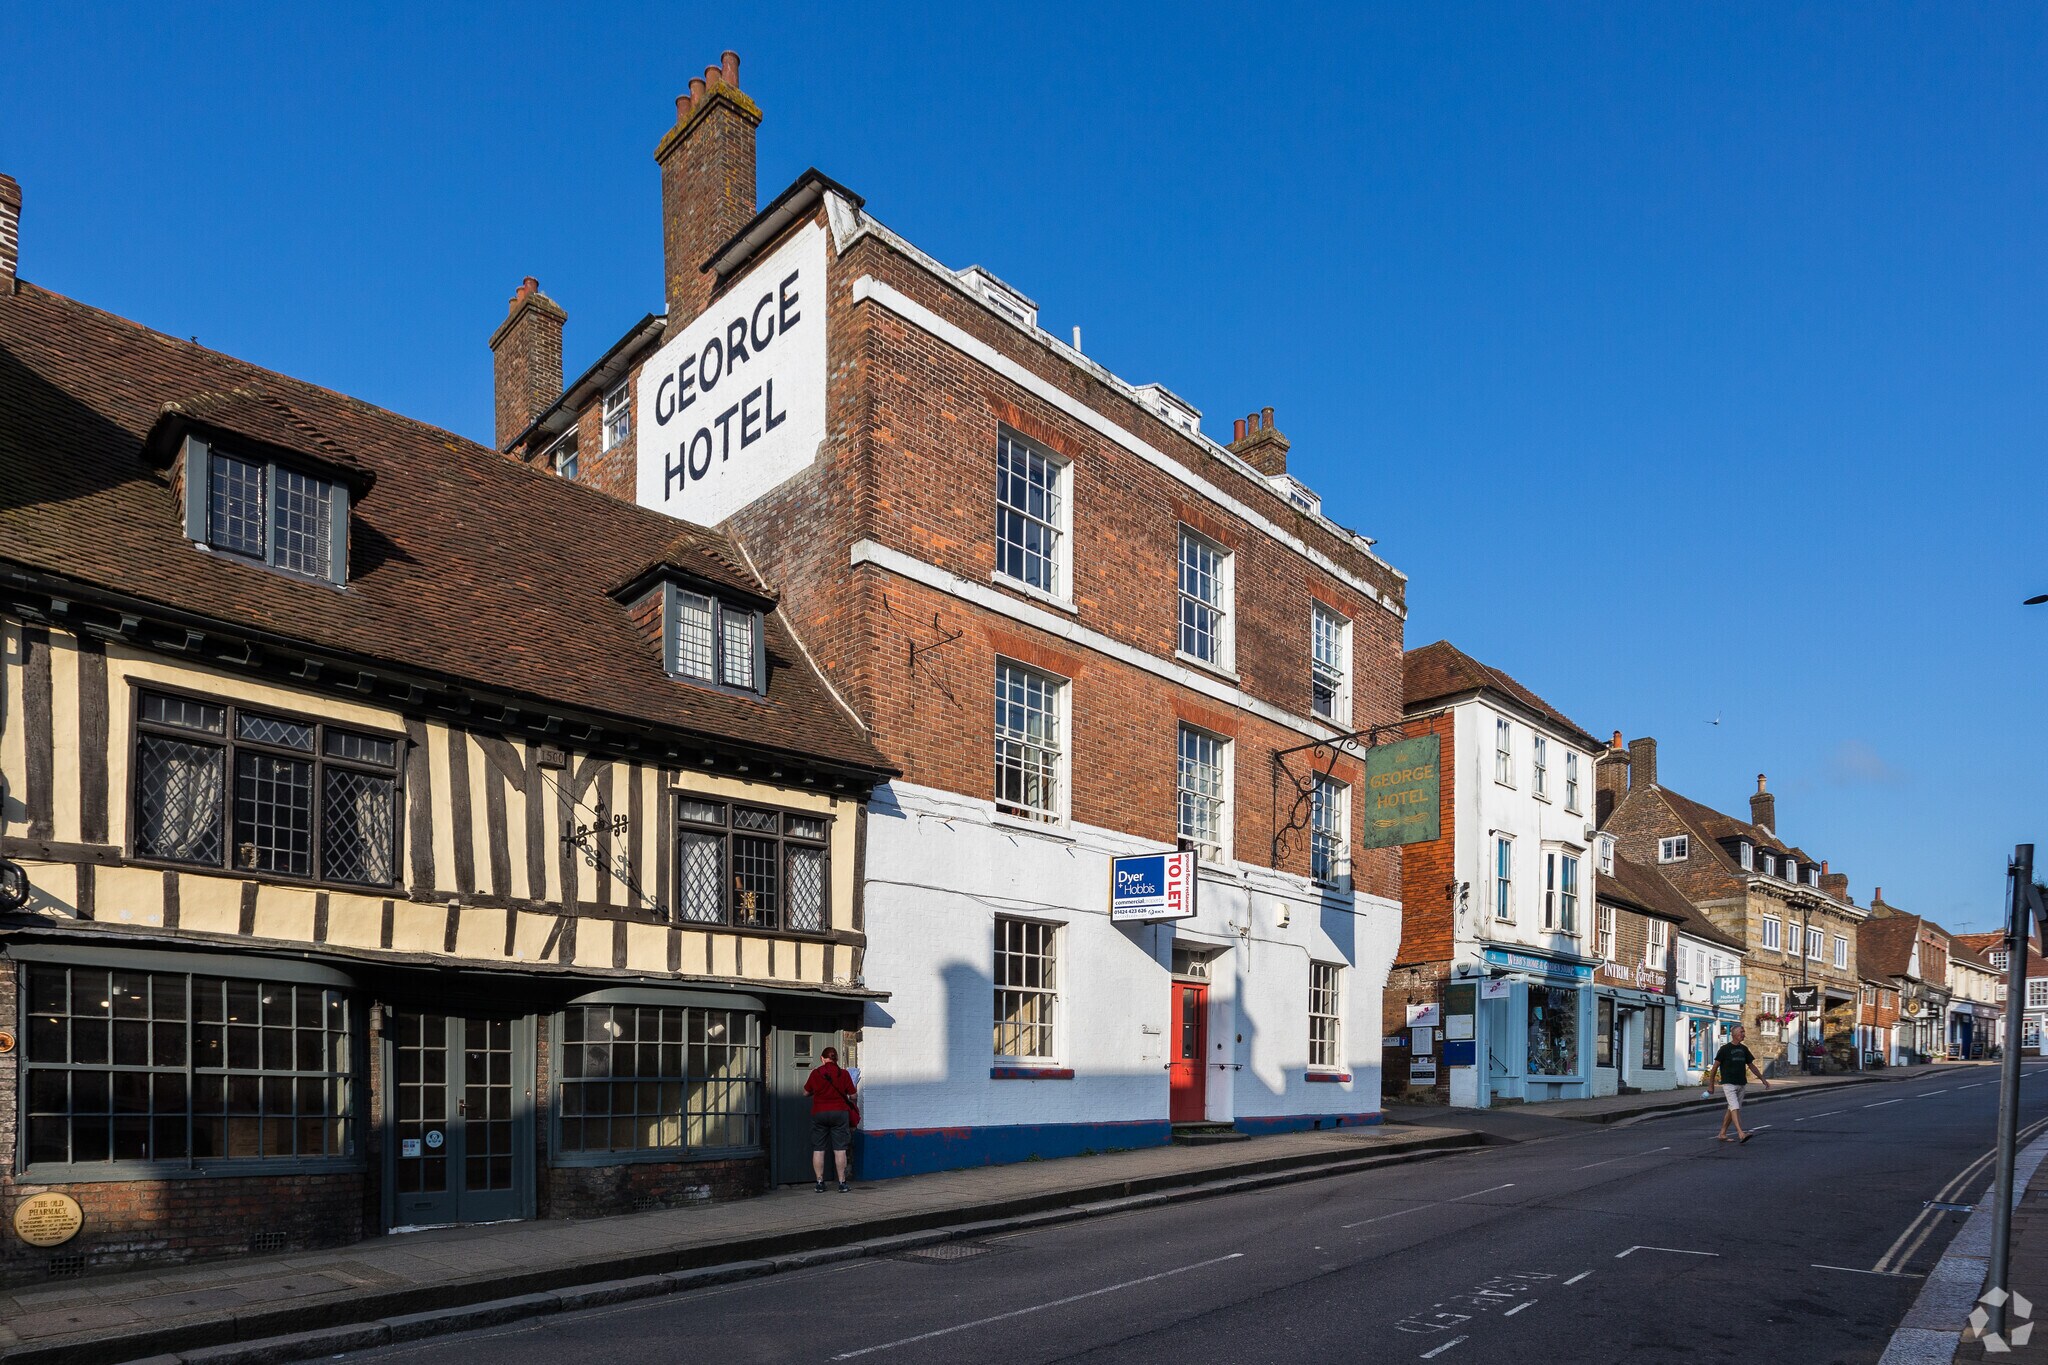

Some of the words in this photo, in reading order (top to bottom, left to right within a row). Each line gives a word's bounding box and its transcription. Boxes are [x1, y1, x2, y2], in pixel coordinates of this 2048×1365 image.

[655, 268, 801, 427] GEORGE
[664, 377, 787, 502] HOTEL
[1369, 764, 1435, 788] GEORGE
[1377, 788, 1429, 809] HOTEL
[1118, 871, 1144, 885] Dyer
[1168, 854, 1182, 878] TO
[1124, 882, 1156, 895] Hobbis
[1168, 881, 1182, 911] LET
[28, 1207, 68, 1217] PHARMACY
[33, 1200, 48, 1208] THE
[50, 1199, 65, 1207] OLD
[1394, 1269, 1558, 1334] DSABED
